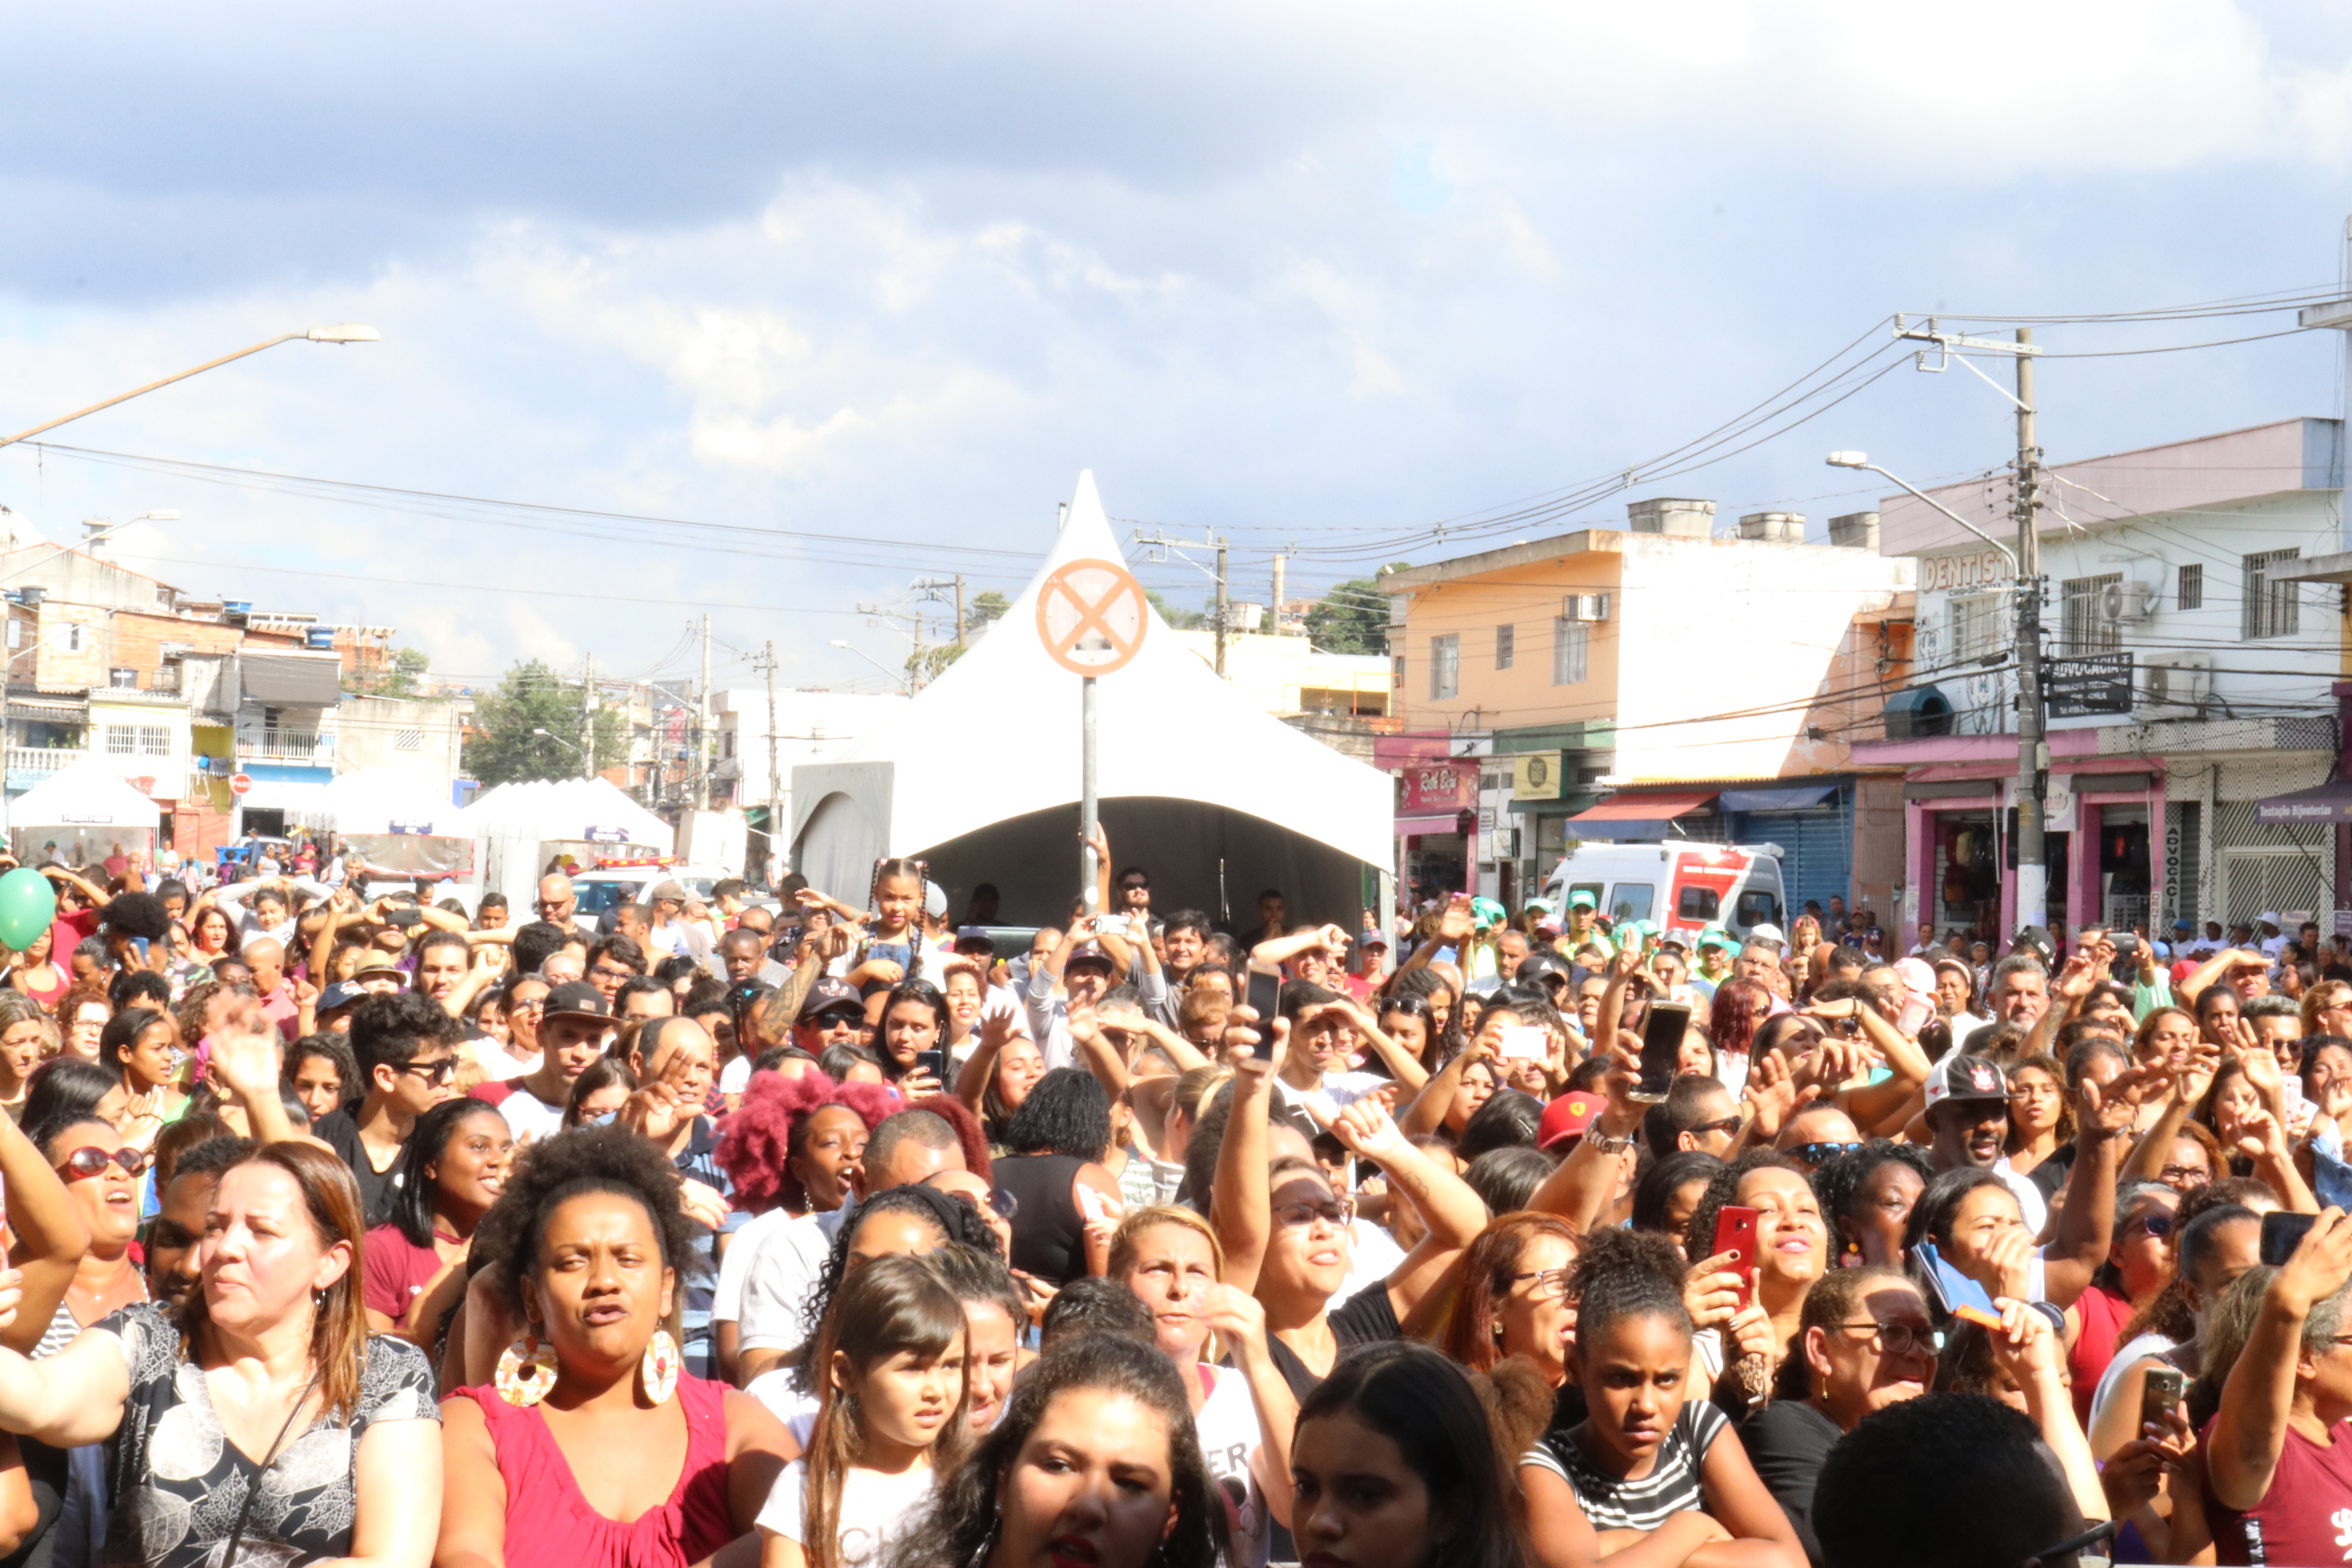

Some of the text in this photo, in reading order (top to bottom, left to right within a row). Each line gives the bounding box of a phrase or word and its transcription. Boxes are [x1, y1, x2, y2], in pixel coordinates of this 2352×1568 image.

[2260, 805, 2290, 819] Tentação
[2292, 804, 2331, 819] Bijouterias
[2165, 827, 2179, 919] ADVOCACIA
